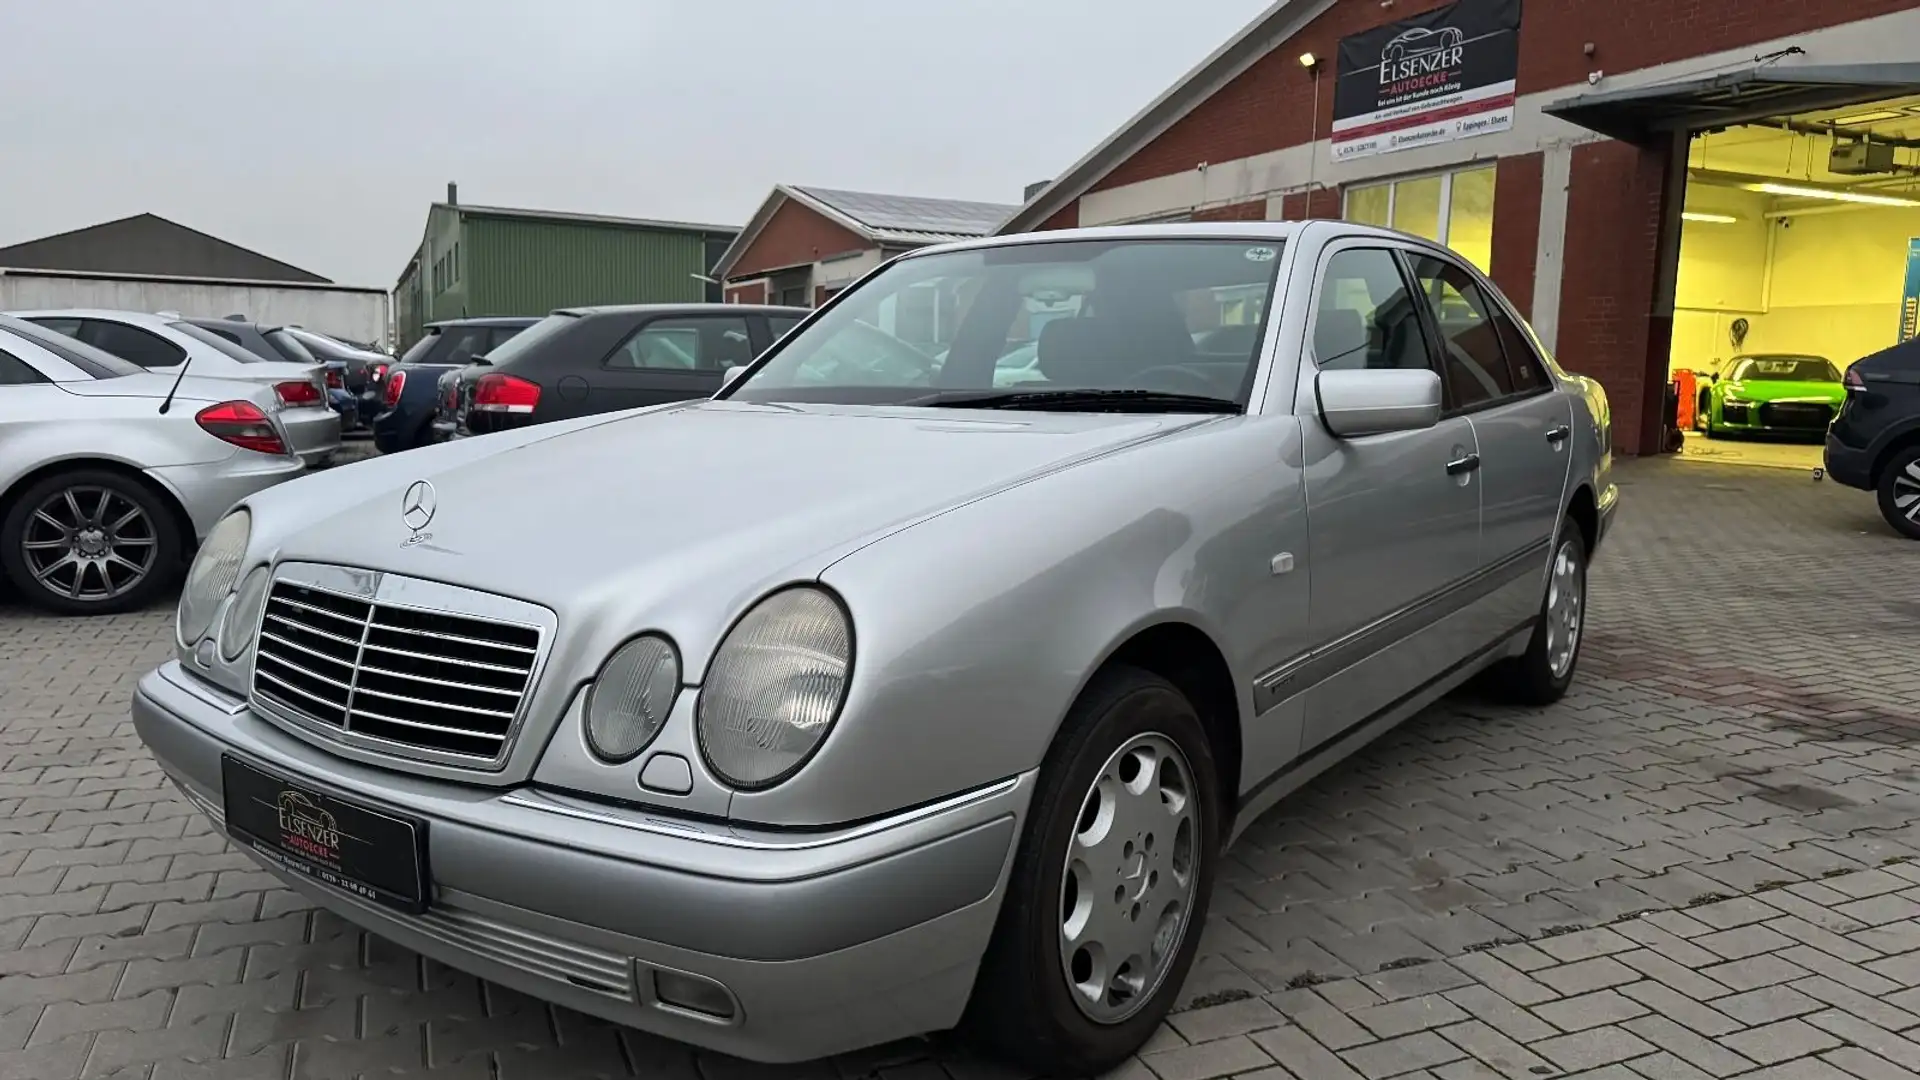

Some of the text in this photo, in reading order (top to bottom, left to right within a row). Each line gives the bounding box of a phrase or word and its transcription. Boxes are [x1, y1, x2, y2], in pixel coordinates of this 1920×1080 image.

[1379, 46, 1463, 85] ELSENZER
[1390, 71, 1448, 95] AUTOECKE
[1412, 89, 1429, 99] Kunde
[1420, 95, 1463, 110] Gebrauchtwagen
[1463, 119, 1487, 131] Eppingen
[1491, 115, 1508, 125] Elsenz
[278, 806, 340, 850] ELSENZER
[289, 835, 329, 858] AUTOECKE
[283, 854, 310, 874] Neuwied
